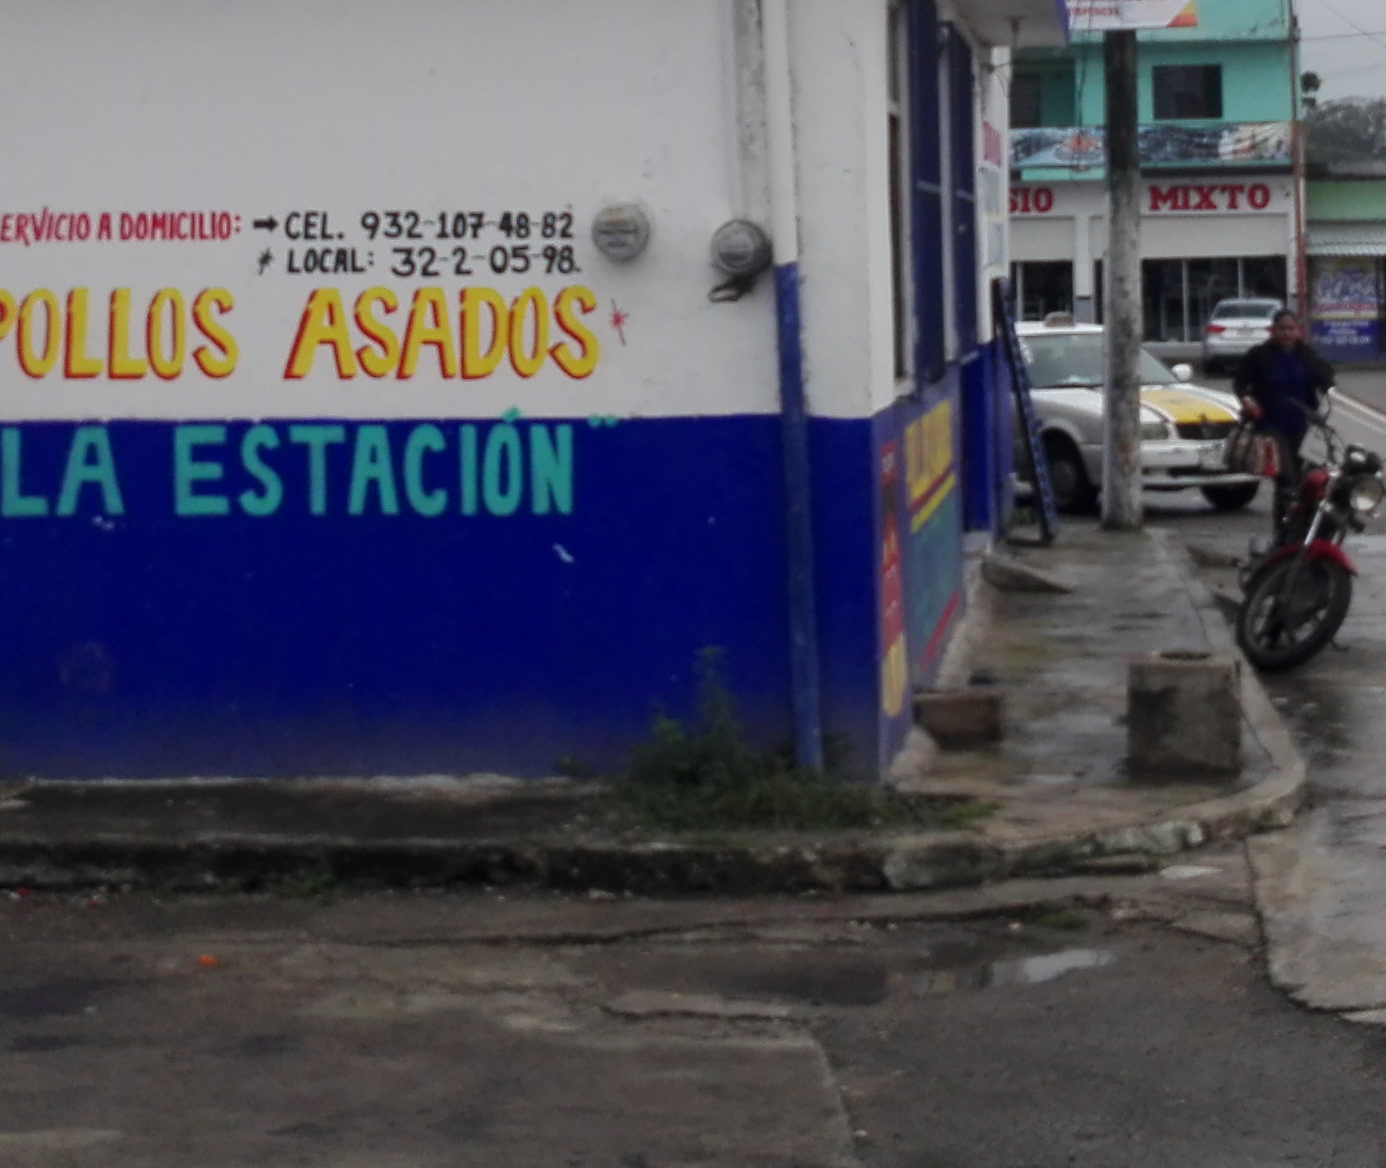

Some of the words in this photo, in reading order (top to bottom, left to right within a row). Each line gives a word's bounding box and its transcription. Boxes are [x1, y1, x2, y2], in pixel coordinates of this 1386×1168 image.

[1148, 184, 1270, 211] MIXTO
[98, 212, 112, 241] A
[120, 211, 241, 241] DOMICILIO:
[285, 211, 344, 240] CEL.
[286, 247, 374, 274] LOCAL:
[283, 284, 601, 381] ASADOS
